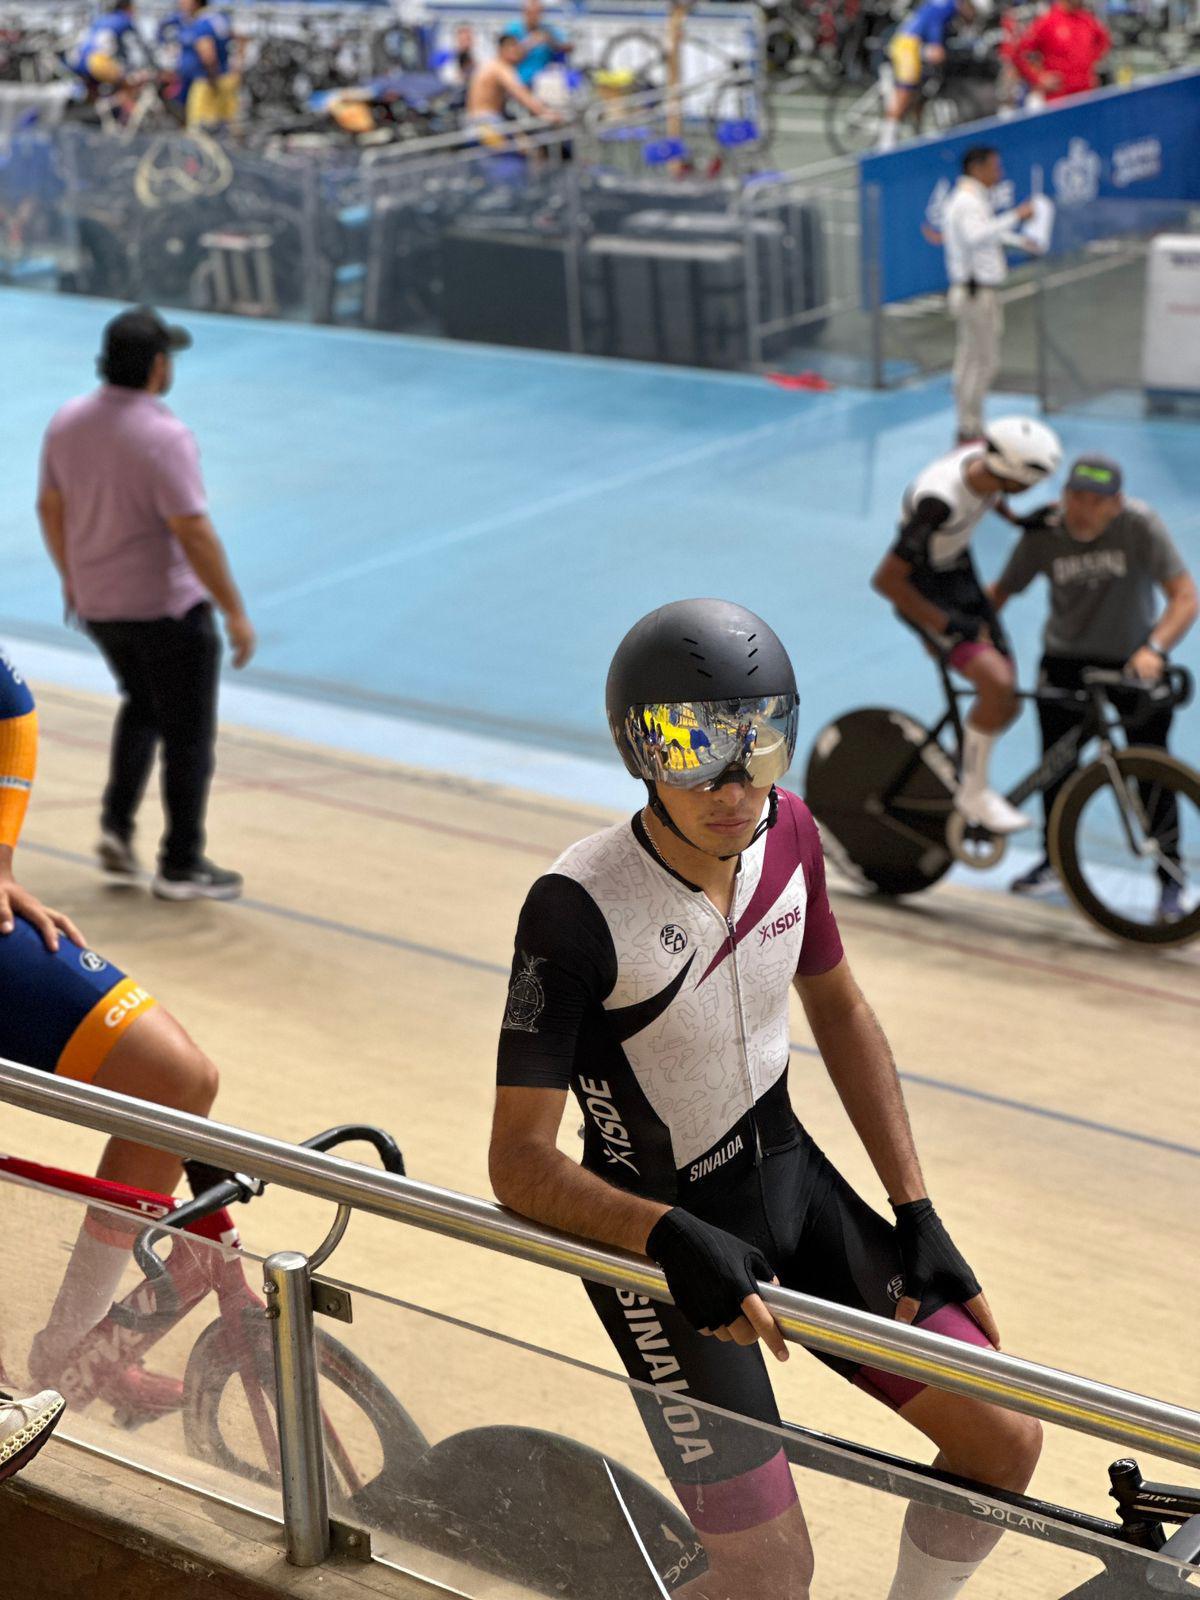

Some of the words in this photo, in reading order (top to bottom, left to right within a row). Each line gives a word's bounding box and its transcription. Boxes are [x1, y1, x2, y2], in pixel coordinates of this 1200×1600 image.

[690, 1134, 744, 1182] SINALOA
[1136, 1492, 1178, 1503] ZIPP
[663, 1541, 705, 1584] DOLA
